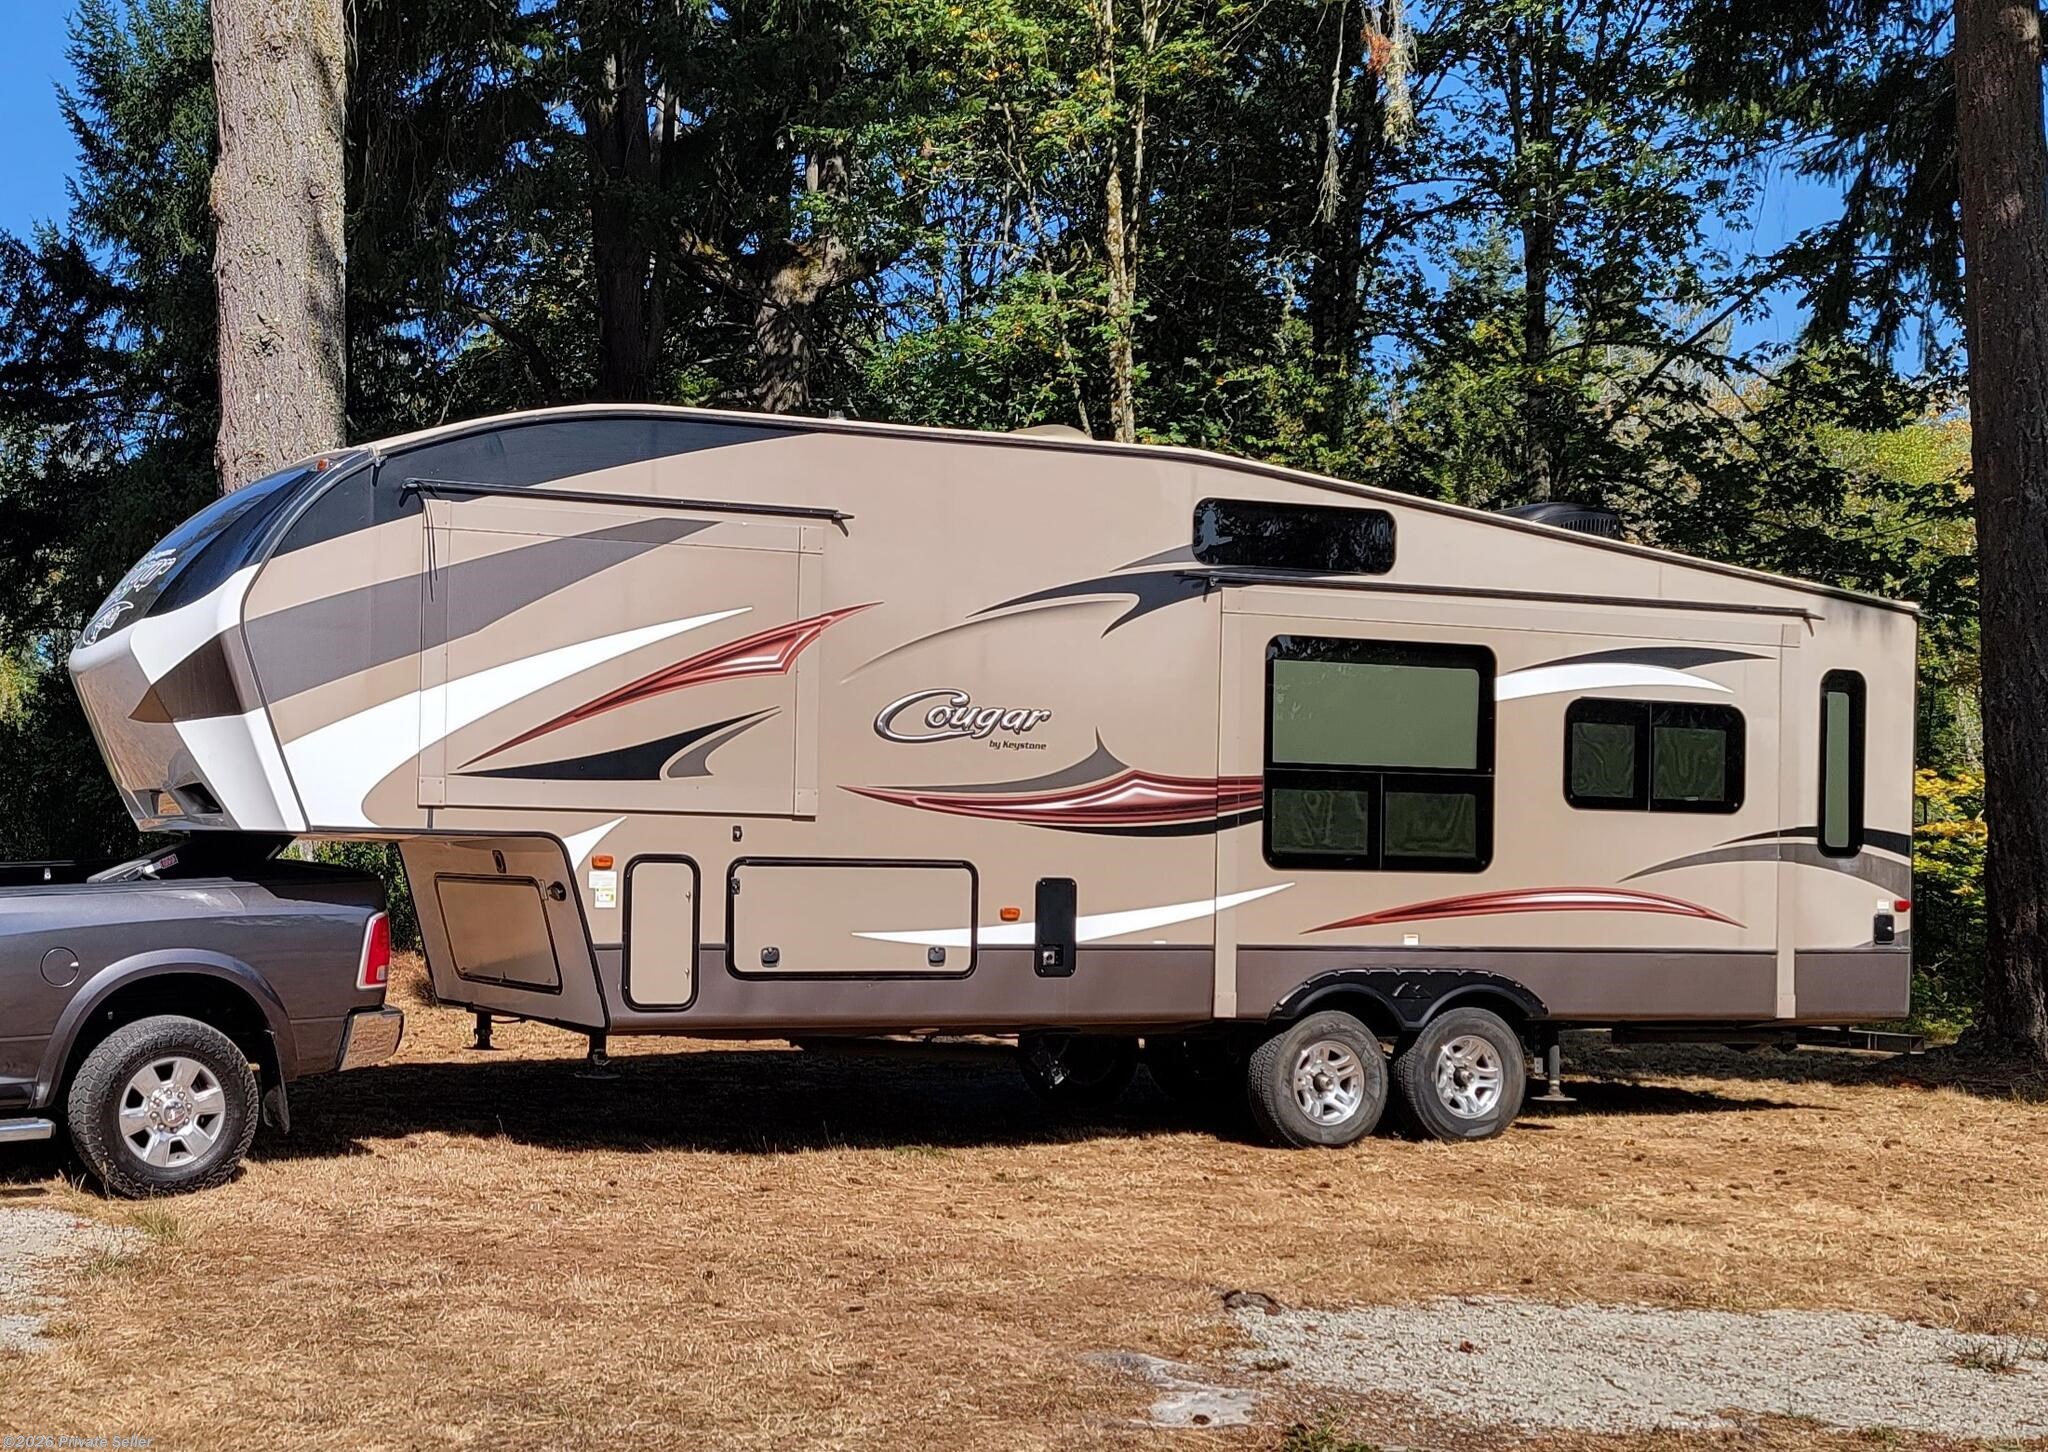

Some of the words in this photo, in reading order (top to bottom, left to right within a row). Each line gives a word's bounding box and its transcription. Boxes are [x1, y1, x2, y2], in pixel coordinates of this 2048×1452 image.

[873, 688, 1052, 744] Cougar
[989, 740, 1001, 750] by
[1002, 740, 1047, 751] Keystone
